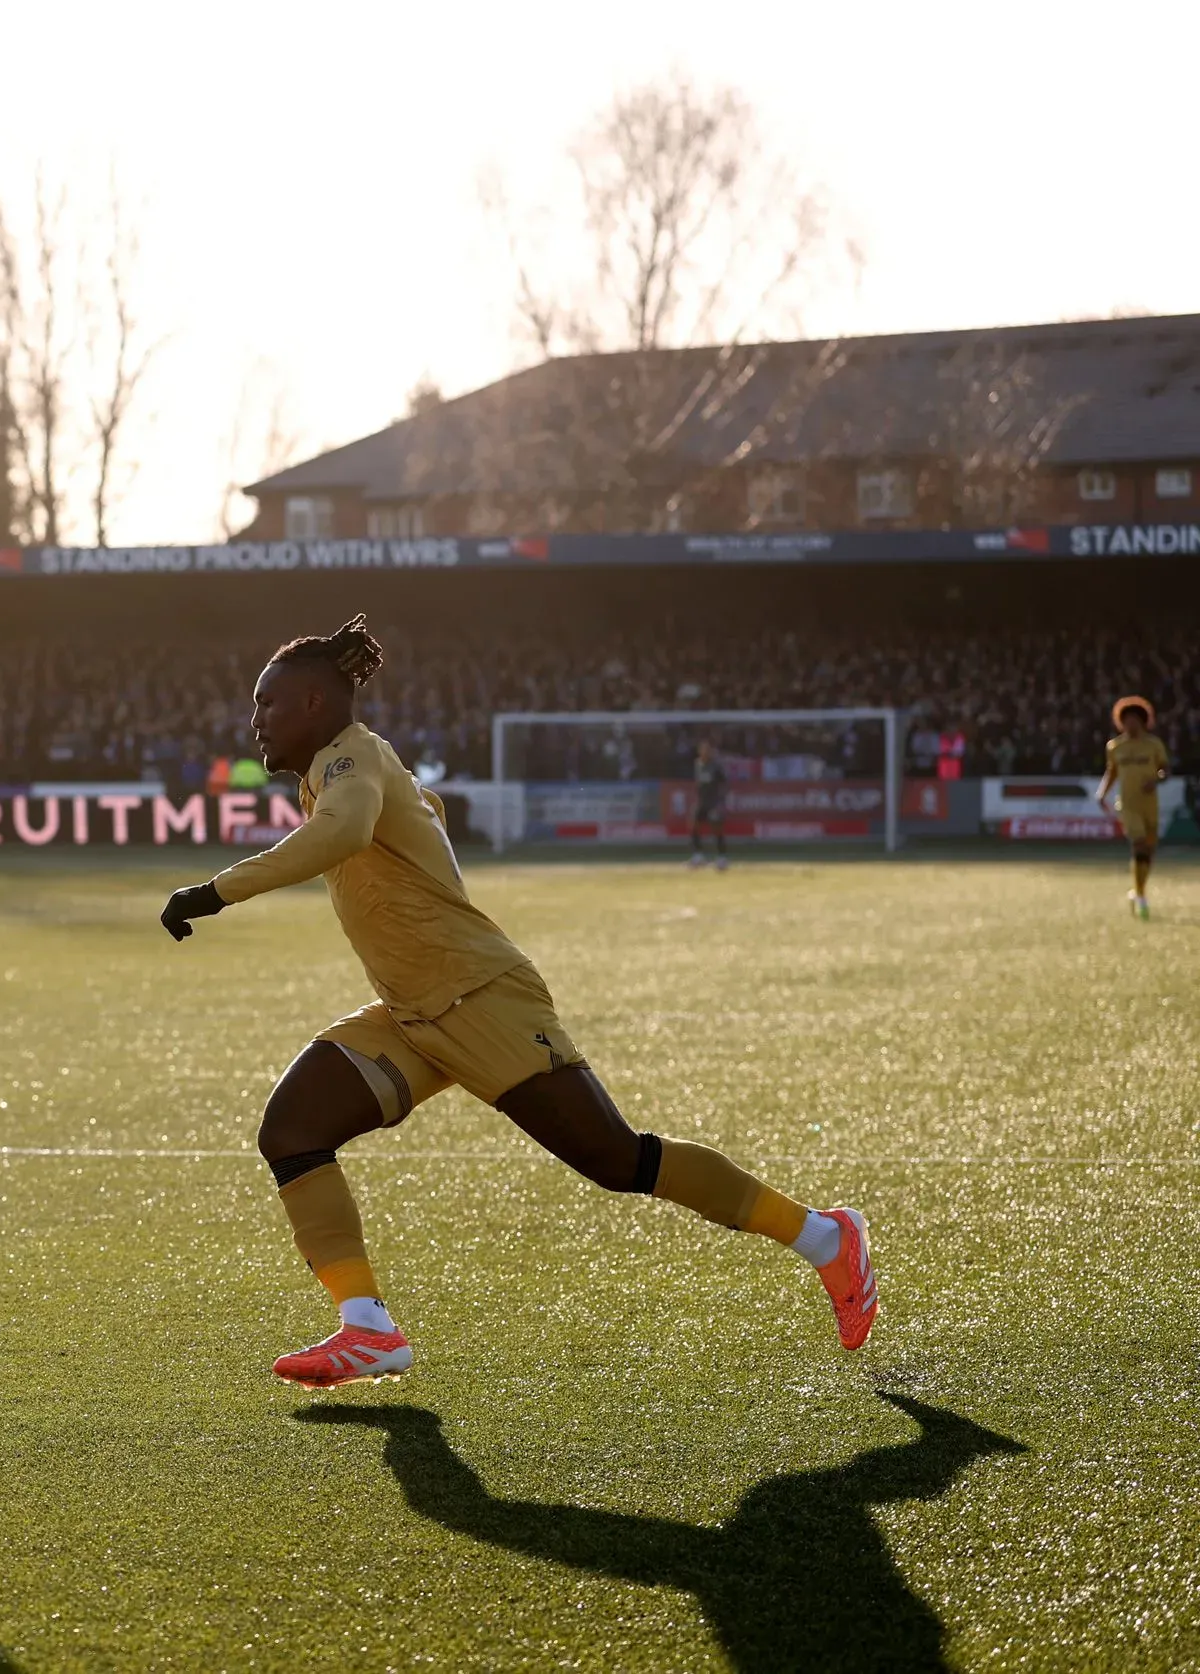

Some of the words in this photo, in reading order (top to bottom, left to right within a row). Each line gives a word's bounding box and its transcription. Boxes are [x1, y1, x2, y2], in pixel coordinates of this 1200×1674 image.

[40, 546, 190, 574] STANDING
[195, 543, 300, 570] PROUD
[306, 539, 384, 567] WITH
[389, 538, 459, 567] WRS
